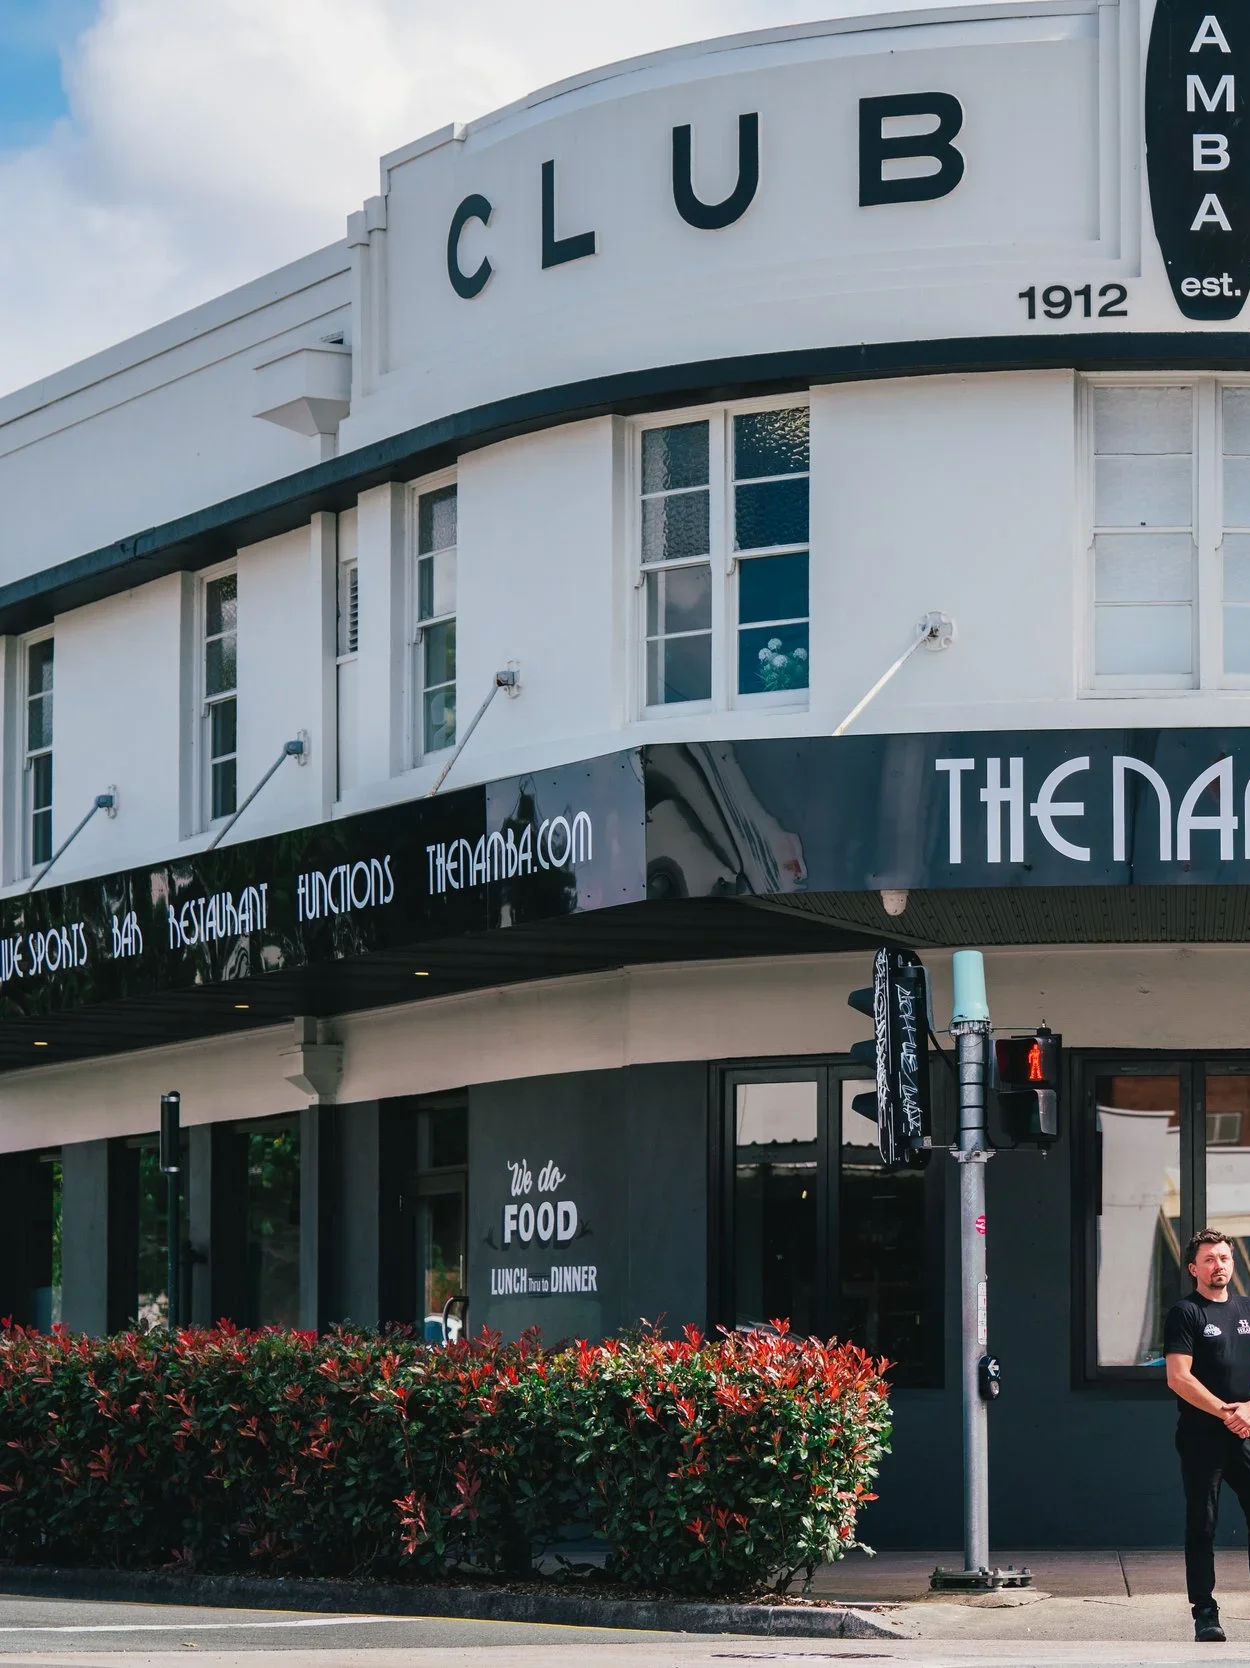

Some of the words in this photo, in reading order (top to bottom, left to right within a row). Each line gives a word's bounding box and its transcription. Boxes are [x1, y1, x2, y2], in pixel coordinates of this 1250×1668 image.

[447, 91, 966, 300] CLUB
[1018, 283, 1129, 319] 1912
[1180, 272, 1242, 298] est.
[28, 921, 88, 976] SPORTS
[111, 909, 143, 958] BAR
[168, 881, 269, 950] RESTAURANT
[297, 853, 395, 922] FUNCTIONS
[426, 810, 593, 896] THENAMBA.COM
[507, 1158, 533, 1196] We
[537, 1159, 566, 1192] do
[503, 1200, 578, 1244] FOOD
[491, 1268, 527, 1295] LUNCH
[550, 1265, 598, 1293] DINNER
